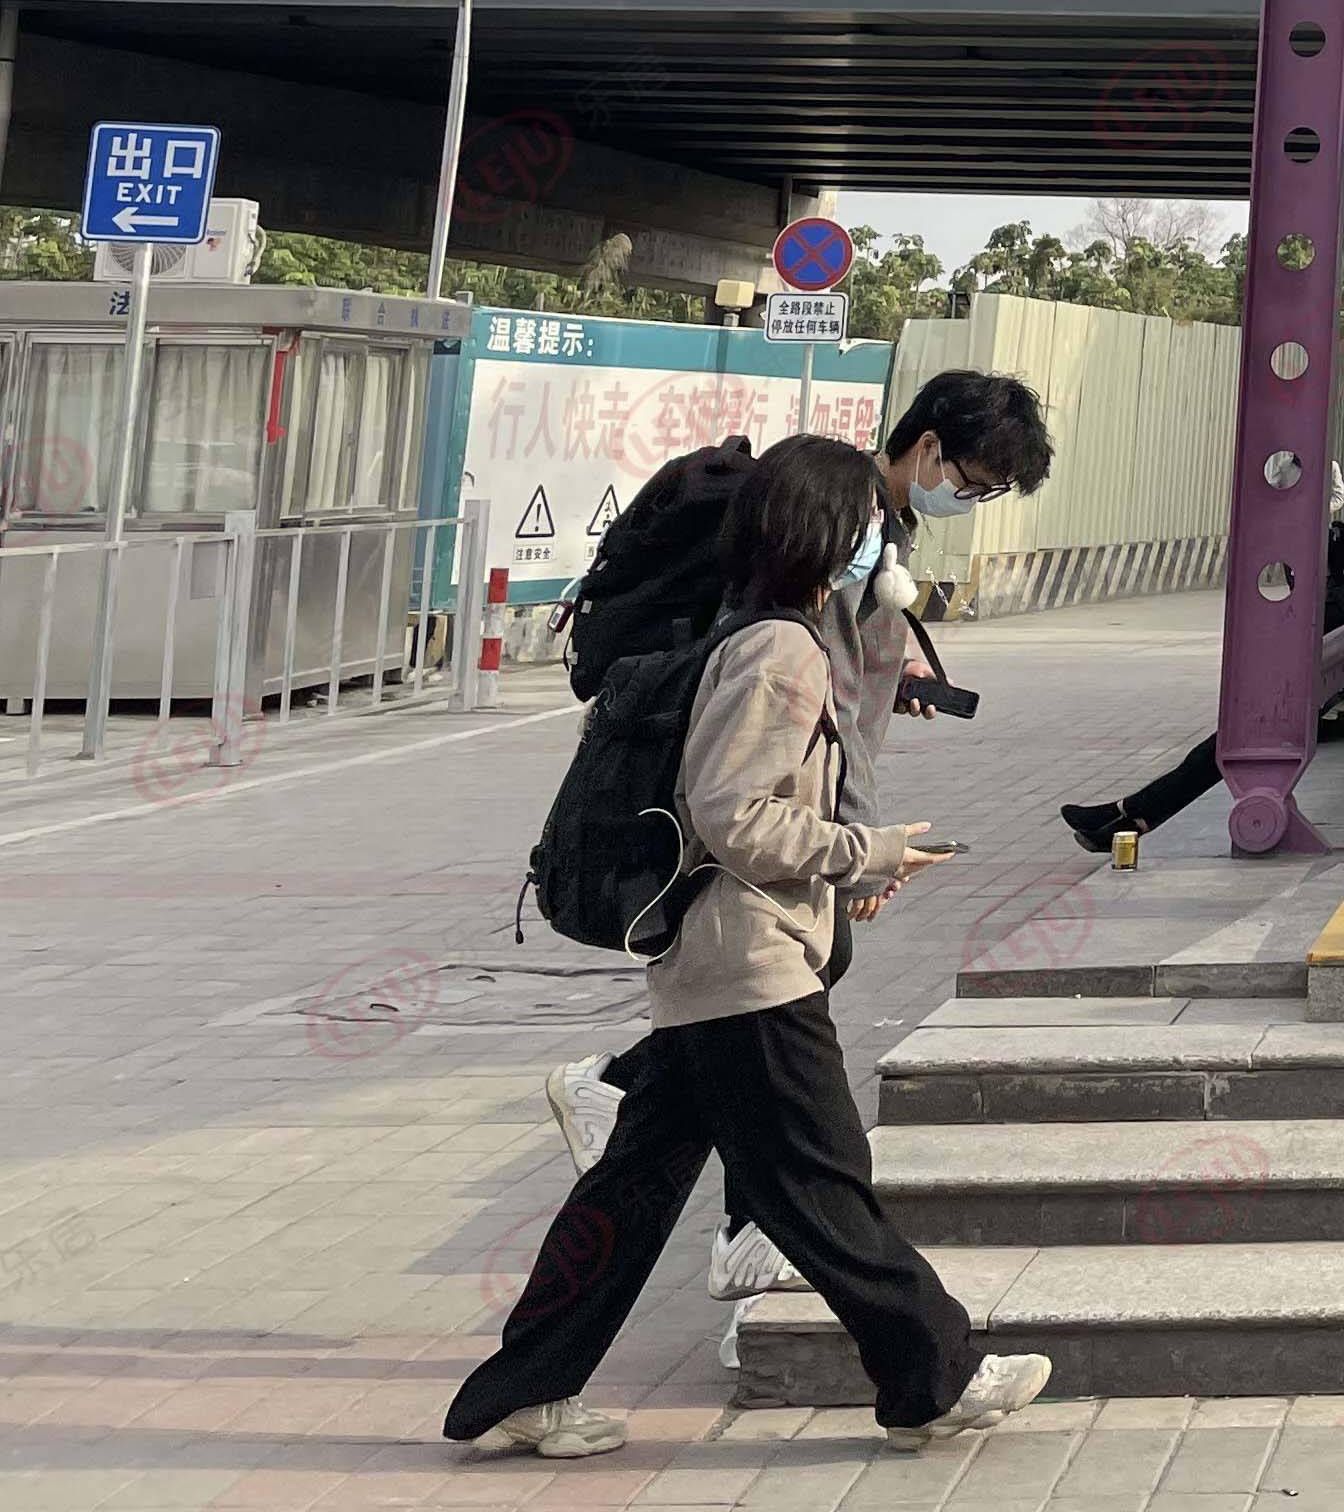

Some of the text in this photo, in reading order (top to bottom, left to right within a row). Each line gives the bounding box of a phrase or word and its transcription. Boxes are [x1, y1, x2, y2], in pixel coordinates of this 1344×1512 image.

[106, 132, 206, 180] 出口
[116, 182, 182, 205] EXIT
[778, 300, 836, 316] 全路段禁止
[771, 319, 841, 335] 停放任何车辆
[487, 376, 630, 461] 行人快走
